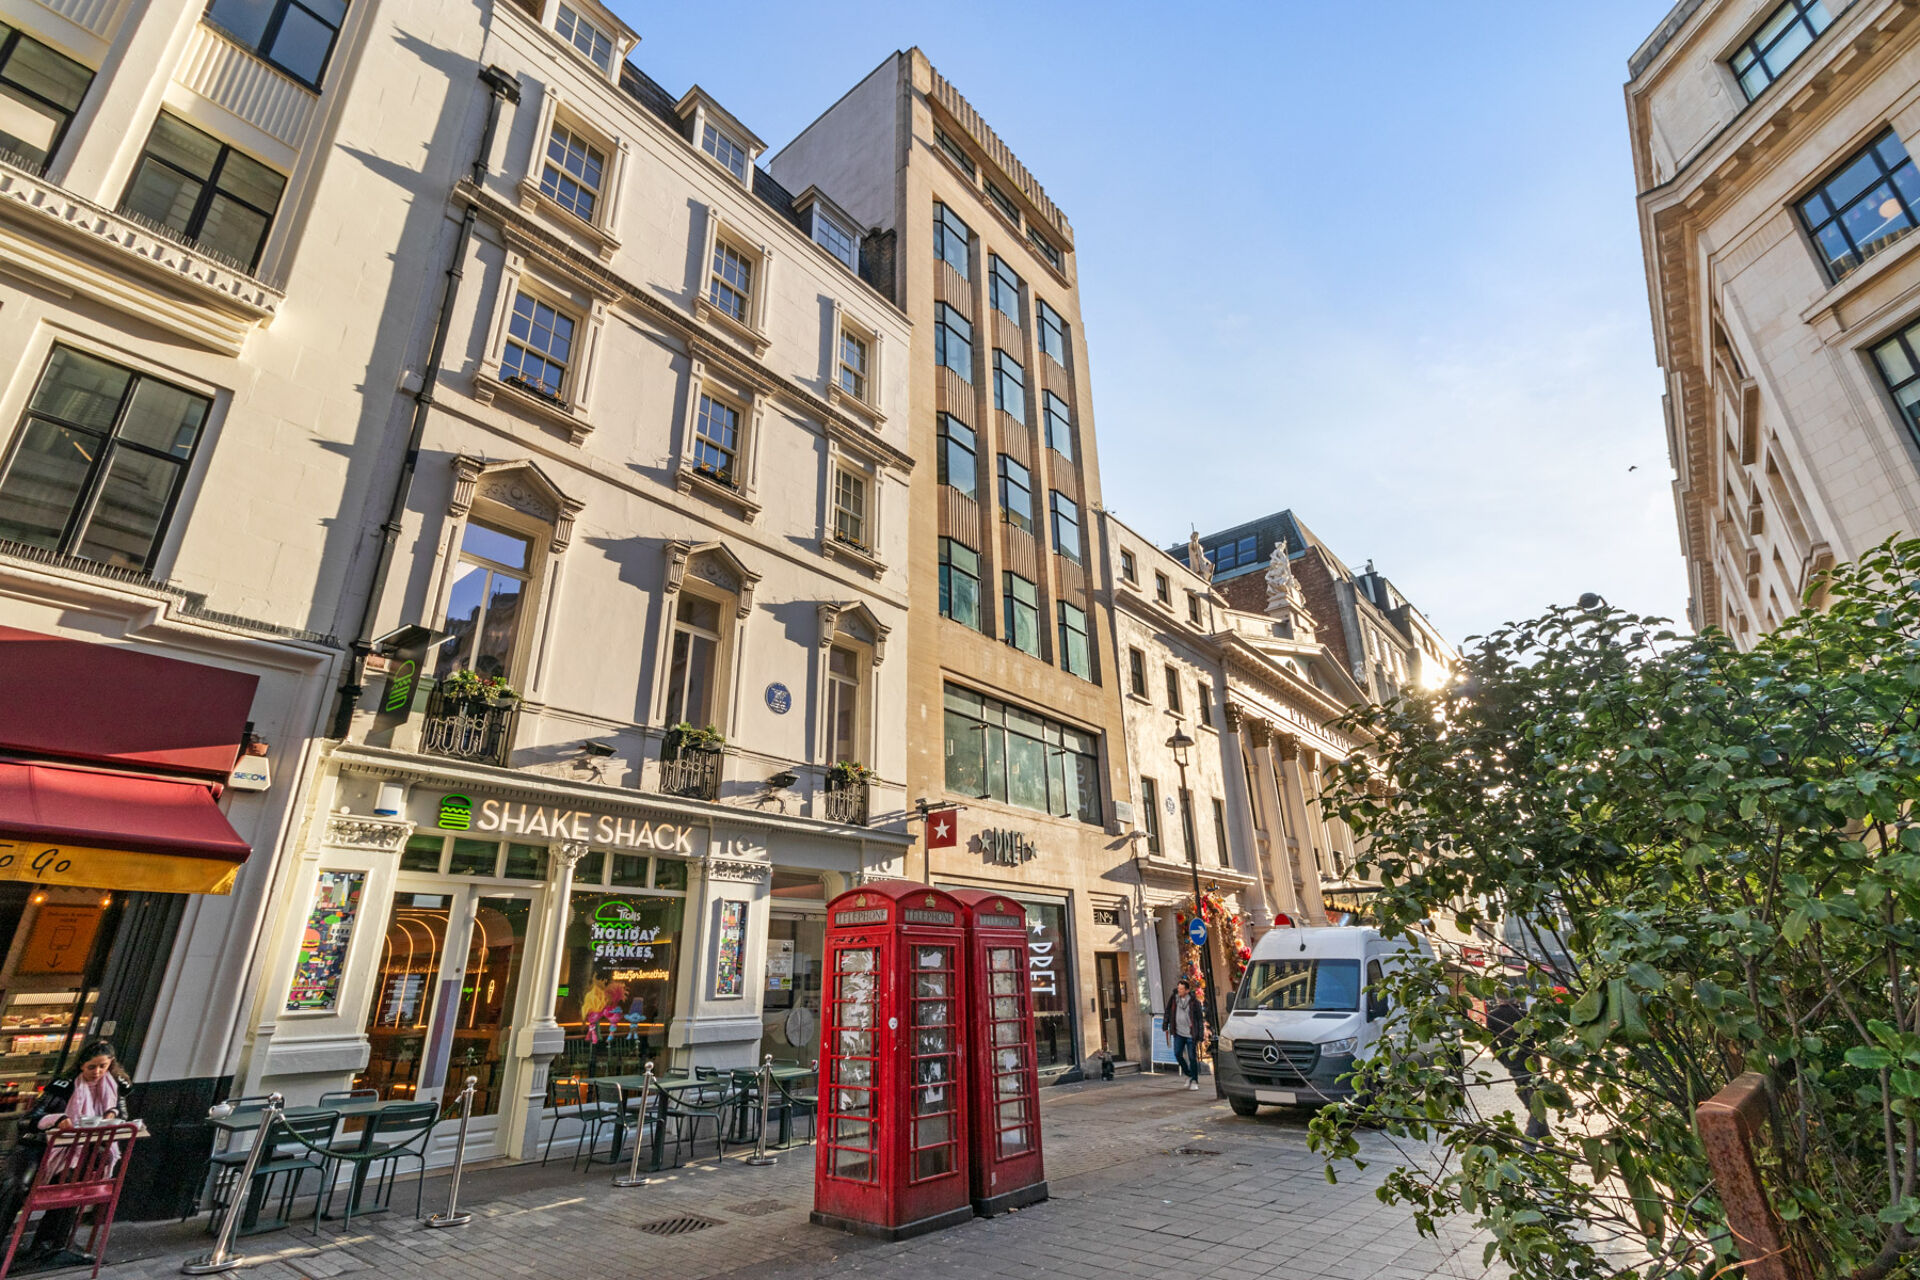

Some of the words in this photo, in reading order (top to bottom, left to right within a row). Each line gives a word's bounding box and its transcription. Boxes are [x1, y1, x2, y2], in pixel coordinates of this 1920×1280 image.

[233, 772, 267, 781] SECOM
[477, 799, 592, 841] SHAKE
[594, 815, 692, 855] SHACK
[993, 826, 1025, 865] PRET
[32, 848, 72, 878] Go
[616, 907, 641, 921] Trolls
[836, 909, 887, 924] TELEPHONE
[905, 910, 955, 924] TELEPHONE
[594, 927, 657, 941] HOLIDAY
[595, 944, 653, 957] SHAKES
[1029, 942, 1056, 996] PRET
